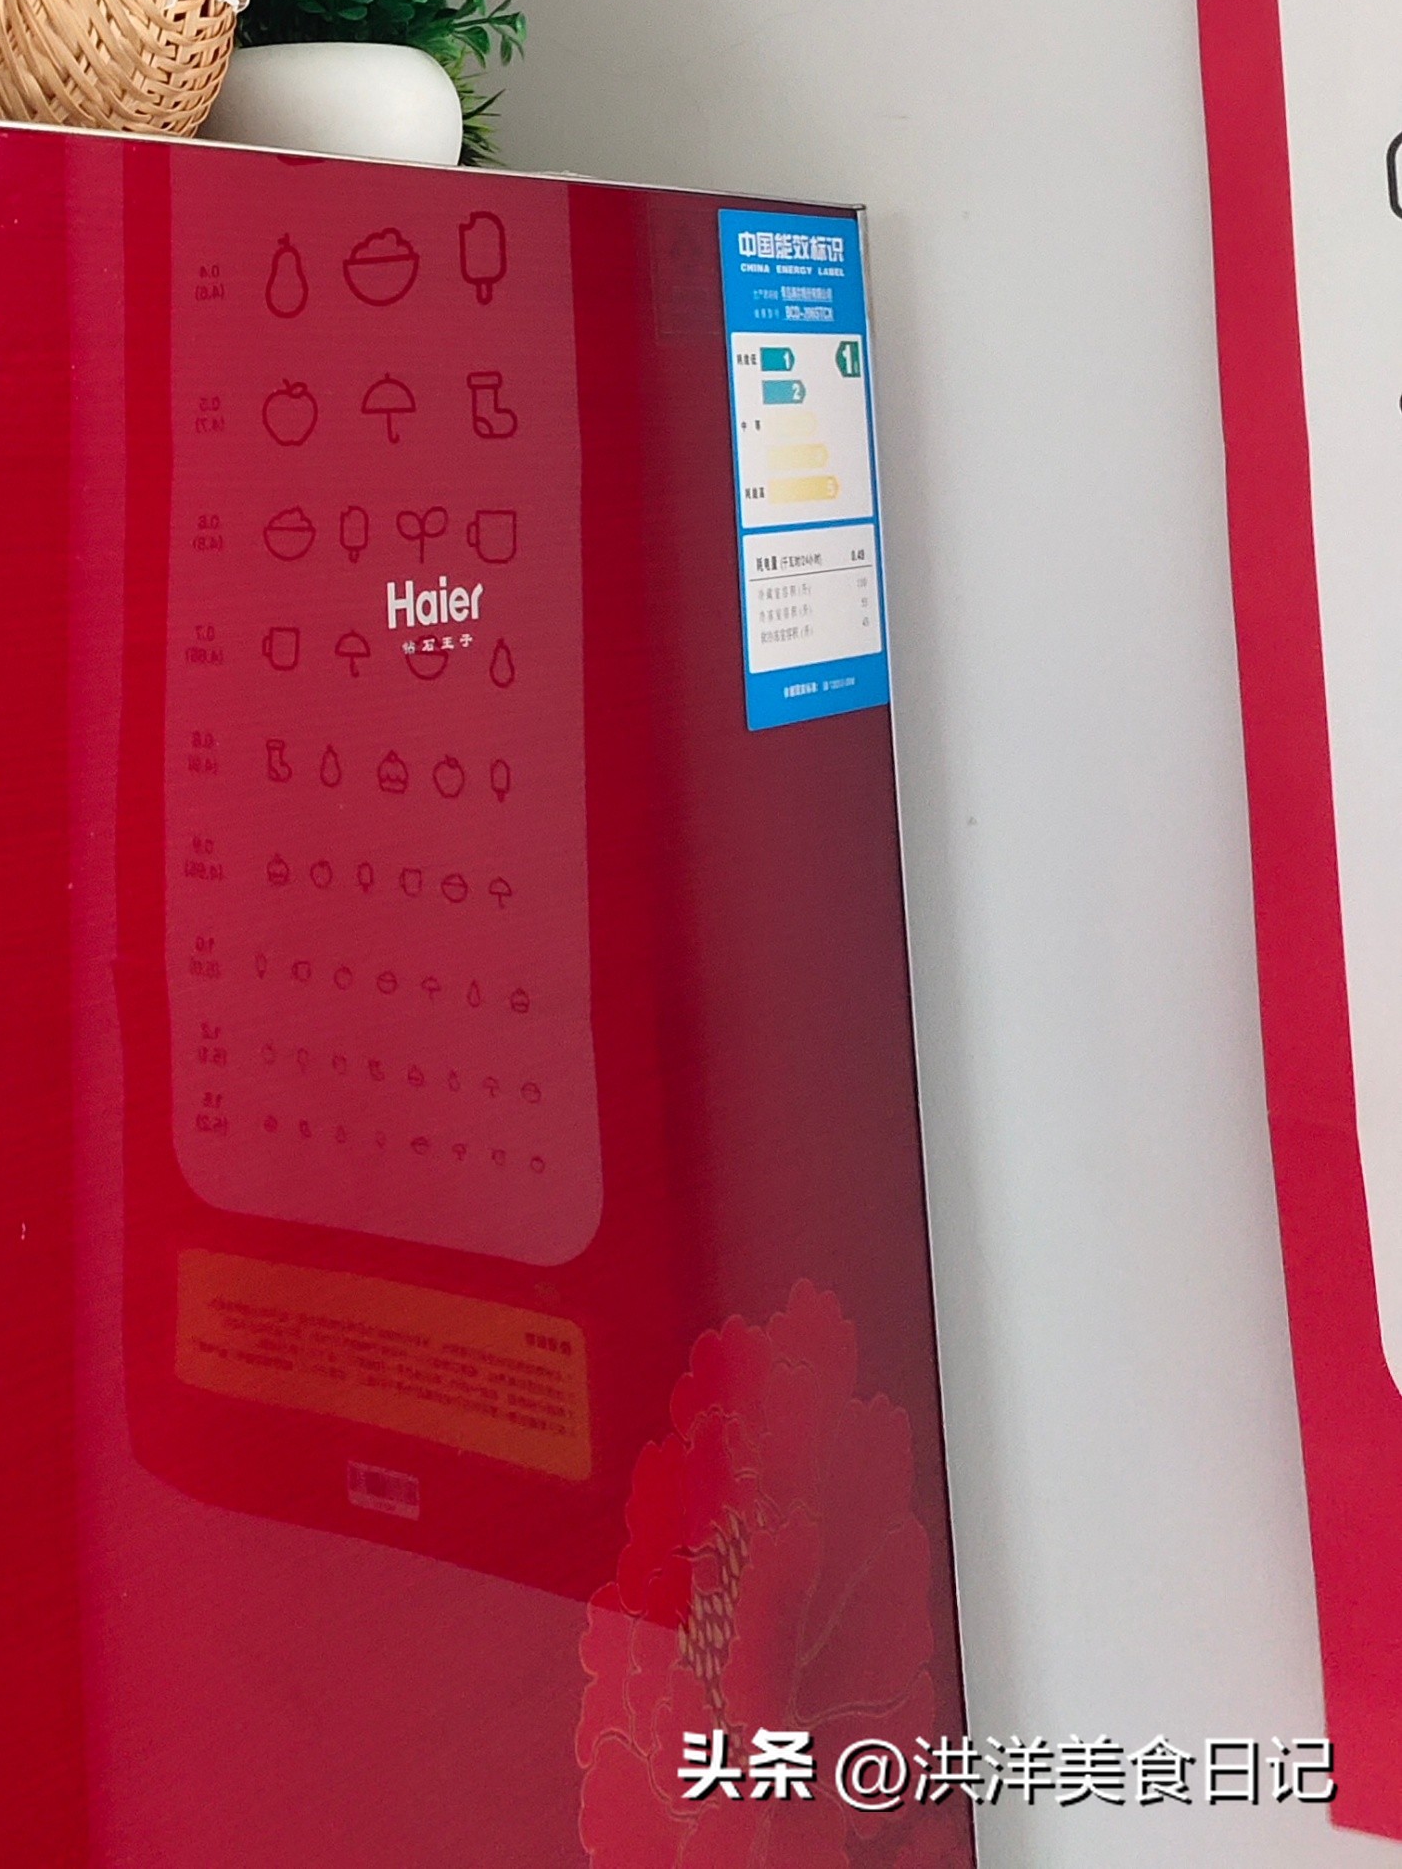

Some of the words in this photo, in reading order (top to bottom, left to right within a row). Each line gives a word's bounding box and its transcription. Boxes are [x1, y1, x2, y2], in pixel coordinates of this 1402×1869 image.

[738, 231, 844, 263] 中国能效标识
[740, 263, 770, 273] CHINA
[776, 264, 812, 275] ENERGY
[818, 267, 845, 277] LABEL
[783, 352, 791, 371] 1
[792, 384, 802, 401] 2
[387, 576, 483, 629] Haier
[402, 633, 473, 654] 钻石王子
